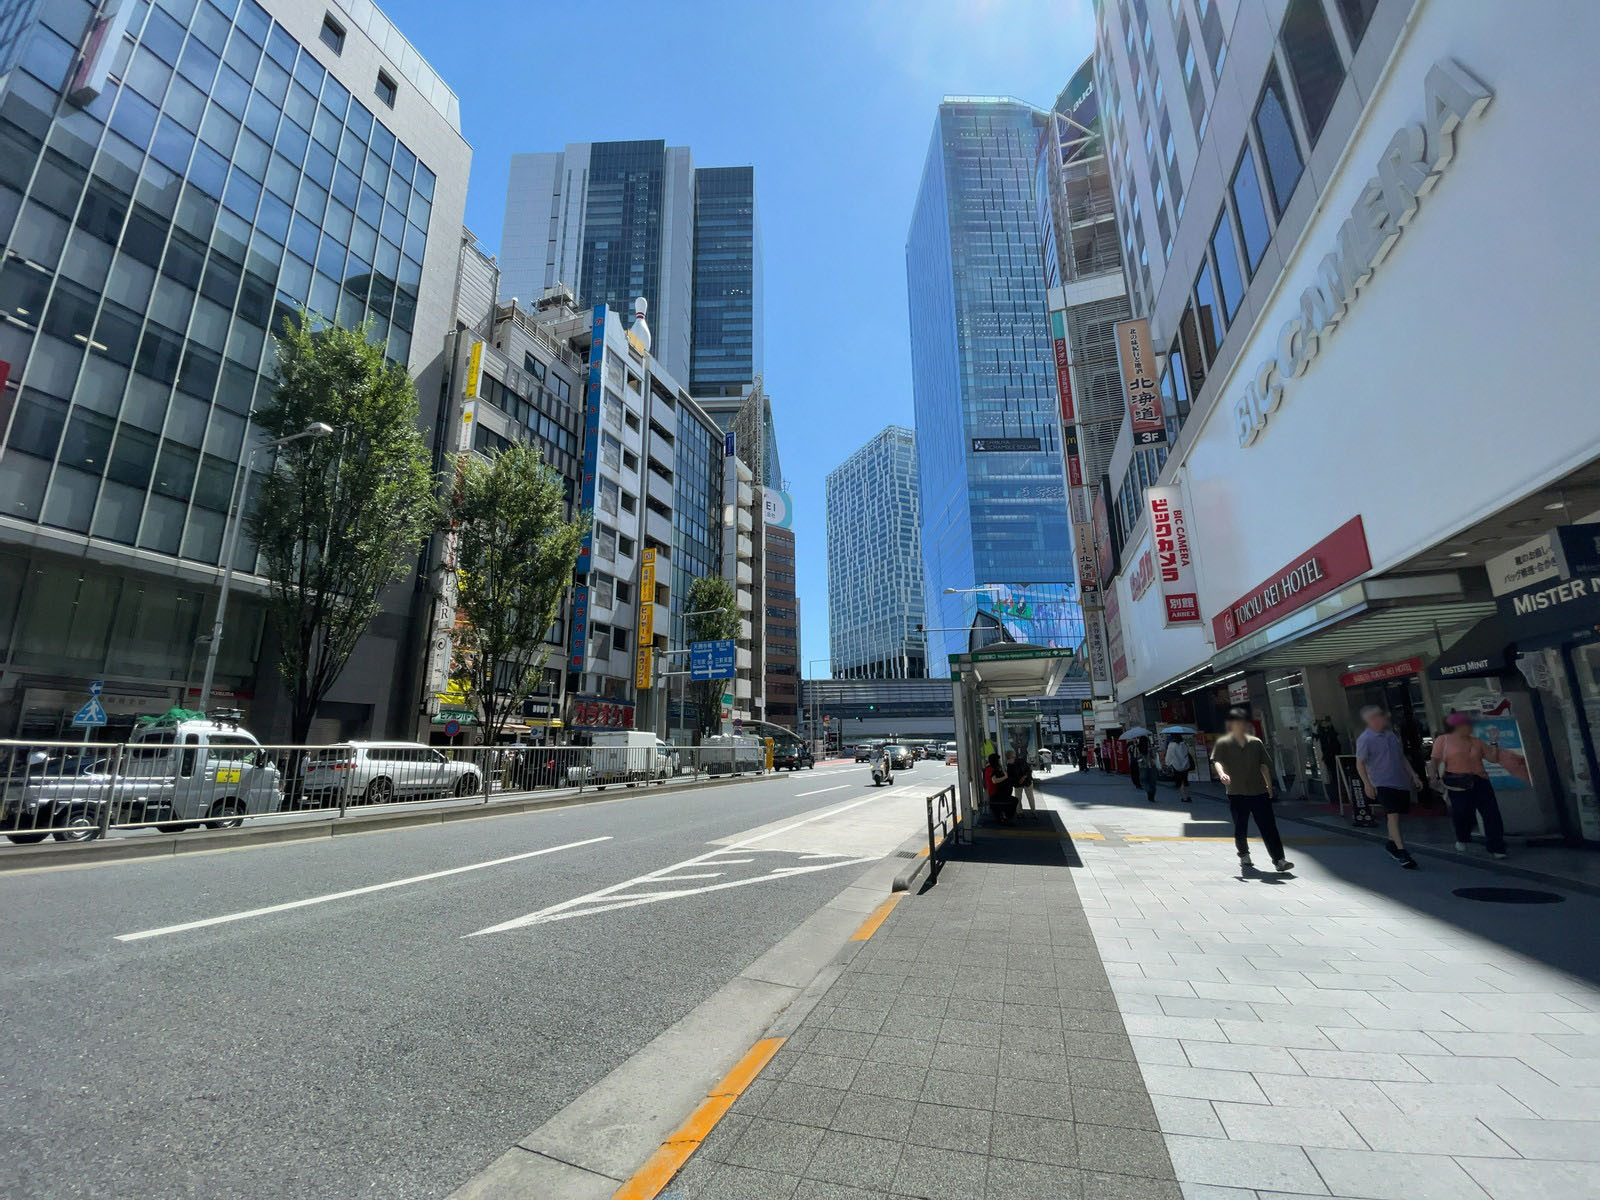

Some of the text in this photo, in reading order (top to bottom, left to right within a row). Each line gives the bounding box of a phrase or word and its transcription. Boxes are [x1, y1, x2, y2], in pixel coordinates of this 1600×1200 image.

[1234, 57, 1495, 449] BIC CAMERA
[1129, 377, 1160, 422] 北海道
[1141, 432, 1159, 443] 3F
[1152, 498, 1179, 583] ビックカメラ
[1173, 509, 1190, 567] BIC CAMERA
[1169, 597, 1195, 609] 別館
[1234, 557, 1323, 626] TOKYU REI HOTEL
[1512, 579, 1587, 616] MISTER
[1440, 659, 1489, 676] MISTER MINIT
